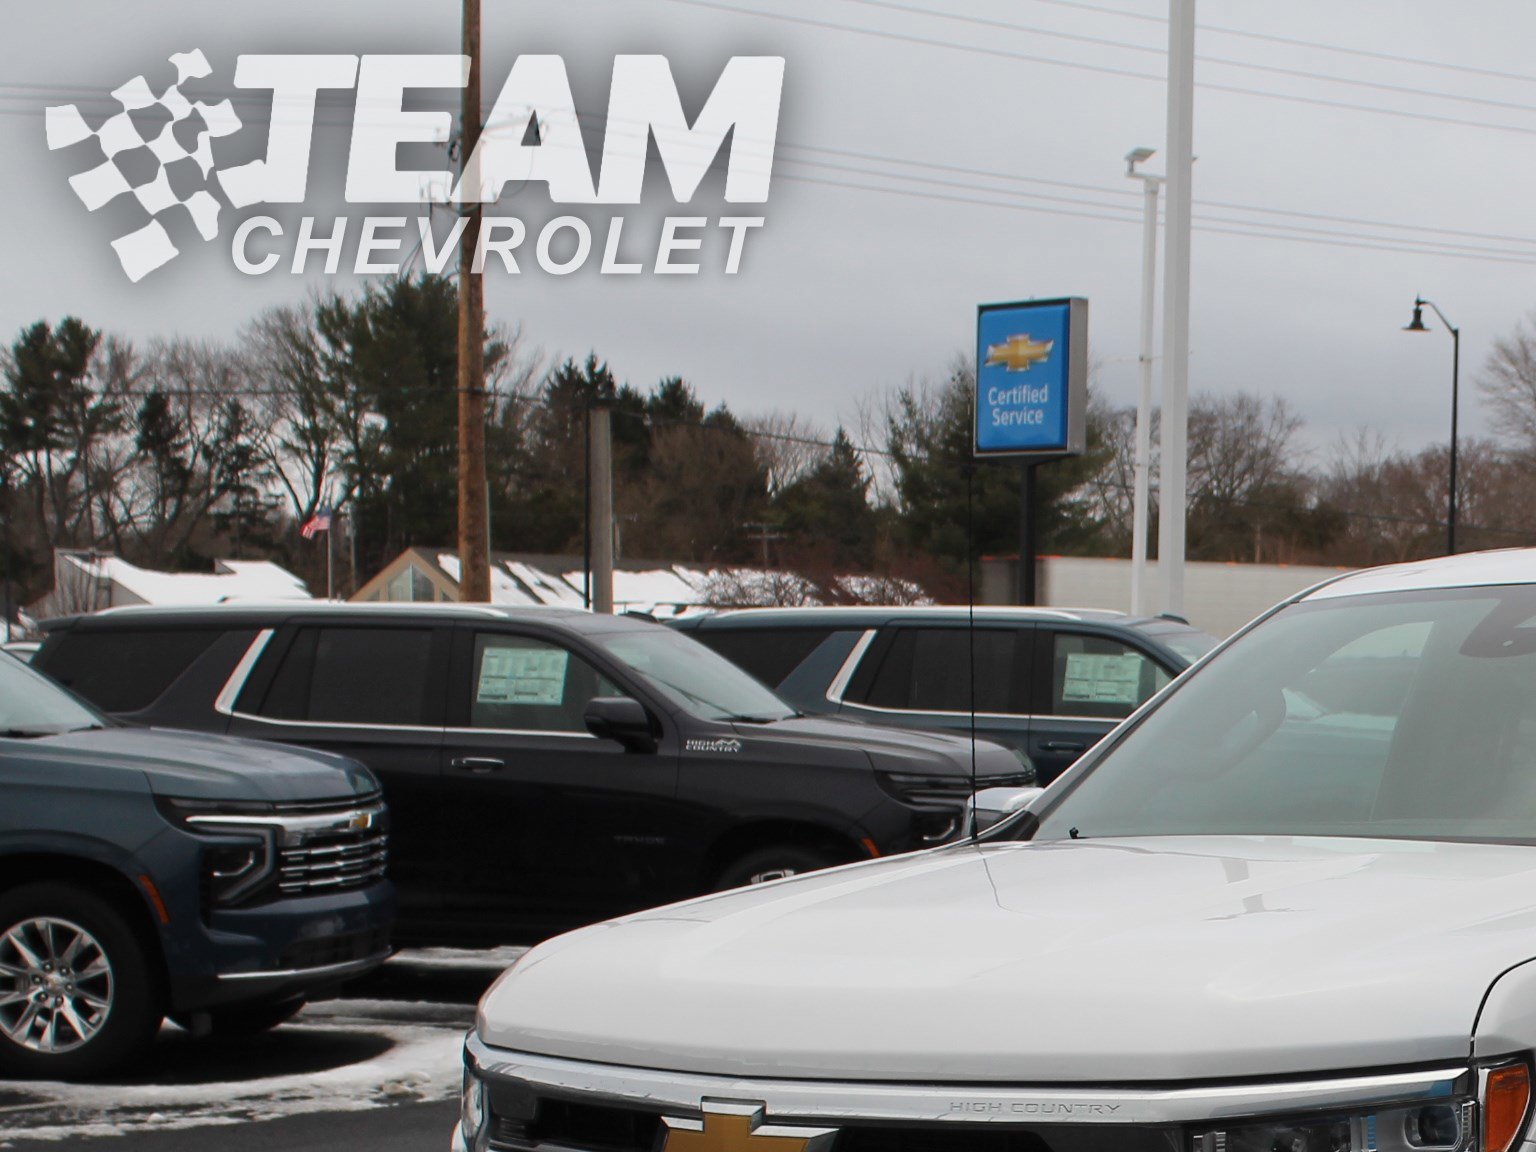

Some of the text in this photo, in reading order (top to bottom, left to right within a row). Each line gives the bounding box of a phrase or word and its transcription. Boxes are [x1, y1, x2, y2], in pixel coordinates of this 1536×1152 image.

[988, 384, 1048, 406] Certified
[992, 407, 1044, 426] Service
[949, 1101, 1121, 1114] HIGH COUNTRY
